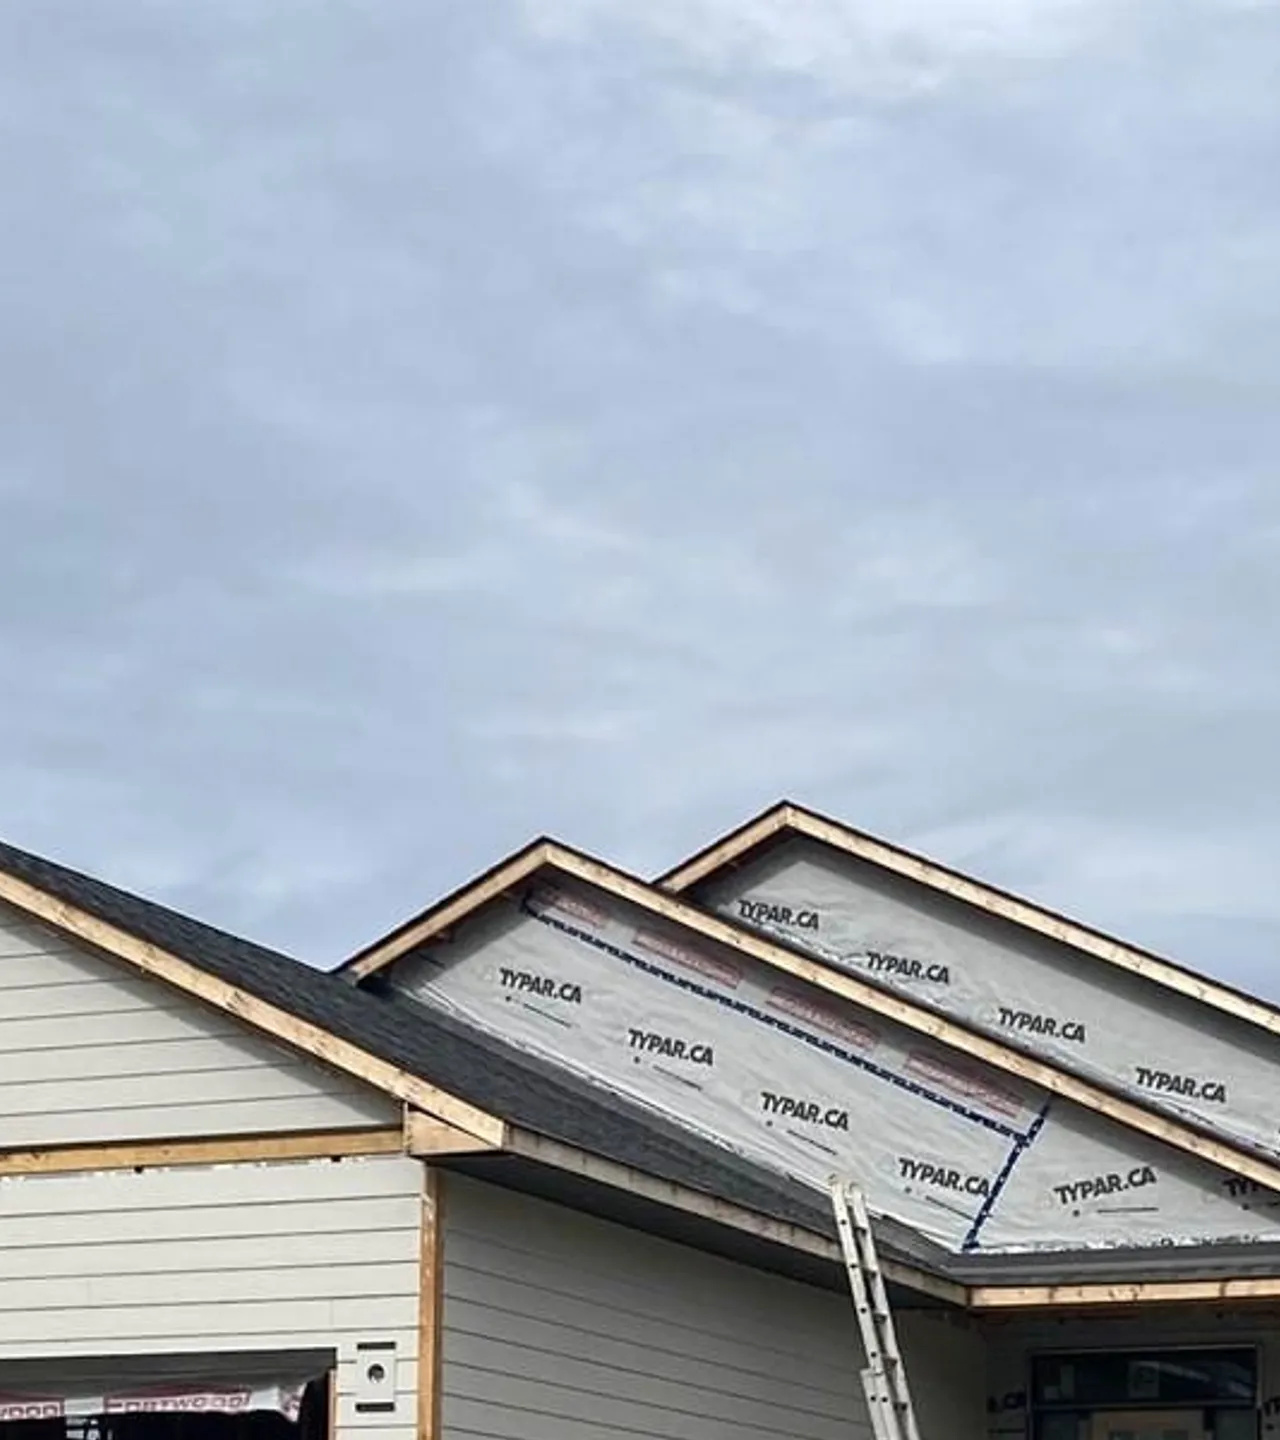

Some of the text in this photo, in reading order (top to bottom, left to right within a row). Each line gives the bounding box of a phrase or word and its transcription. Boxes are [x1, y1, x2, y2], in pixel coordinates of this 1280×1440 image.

[738, 899, 820, 931] TYPAR.CA
[499, 967, 583, 1005] TYPAR.CA
[866, 951, 951, 985] TYPAR.CA
[997, 1007, 1087, 1044] TYPAR.CA
[628, 1028, 715, 1068] TYPAR.CA
[1135, 1066, 1227, 1103] TYPAR.CA
[761, 1092, 851, 1132] TYPAR.CA
[899, 1156, 991, 1198] TYPAR.CA
[1054, 1166, 1158, 1206] TYPAR.CA
